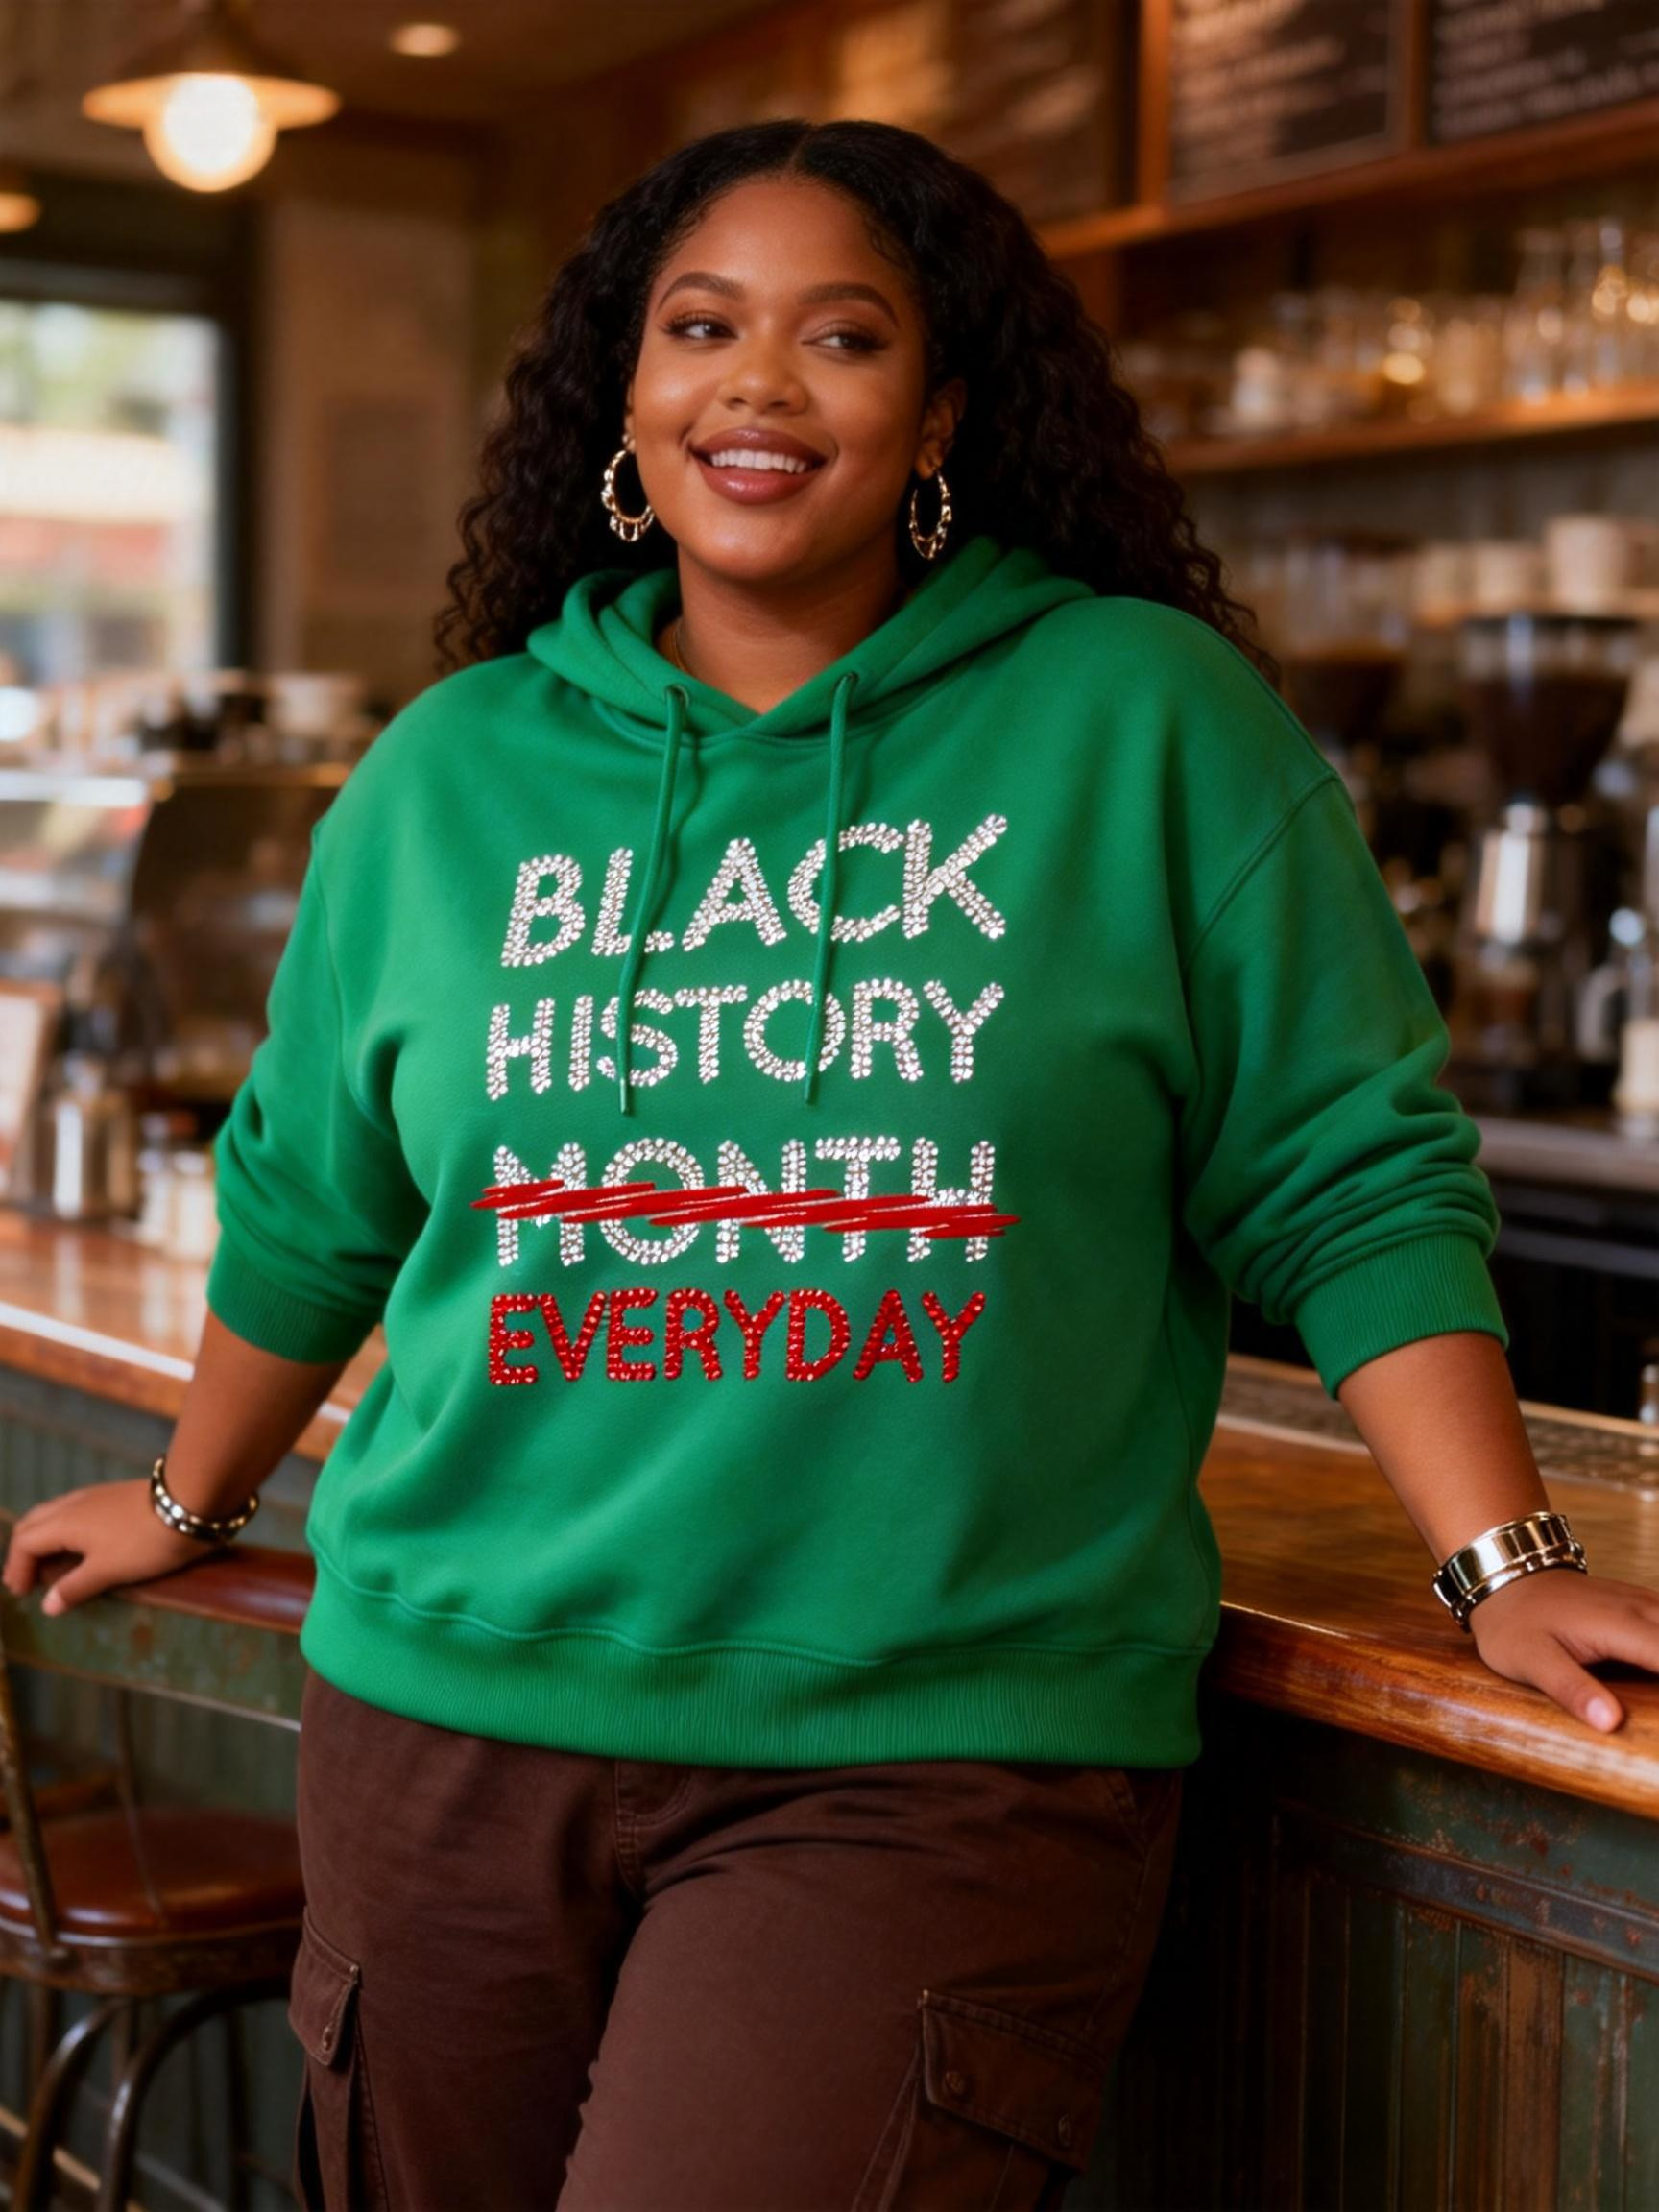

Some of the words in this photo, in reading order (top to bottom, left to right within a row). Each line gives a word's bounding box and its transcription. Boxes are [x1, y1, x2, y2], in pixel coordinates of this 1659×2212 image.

[500, 814, 1007, 967] BLACK
[486, 977, 1005, 1100] HISTORY
[493, 1136, 997, 1266] MONTH
[489, 1287, 986, 1385] EVERYDAY
